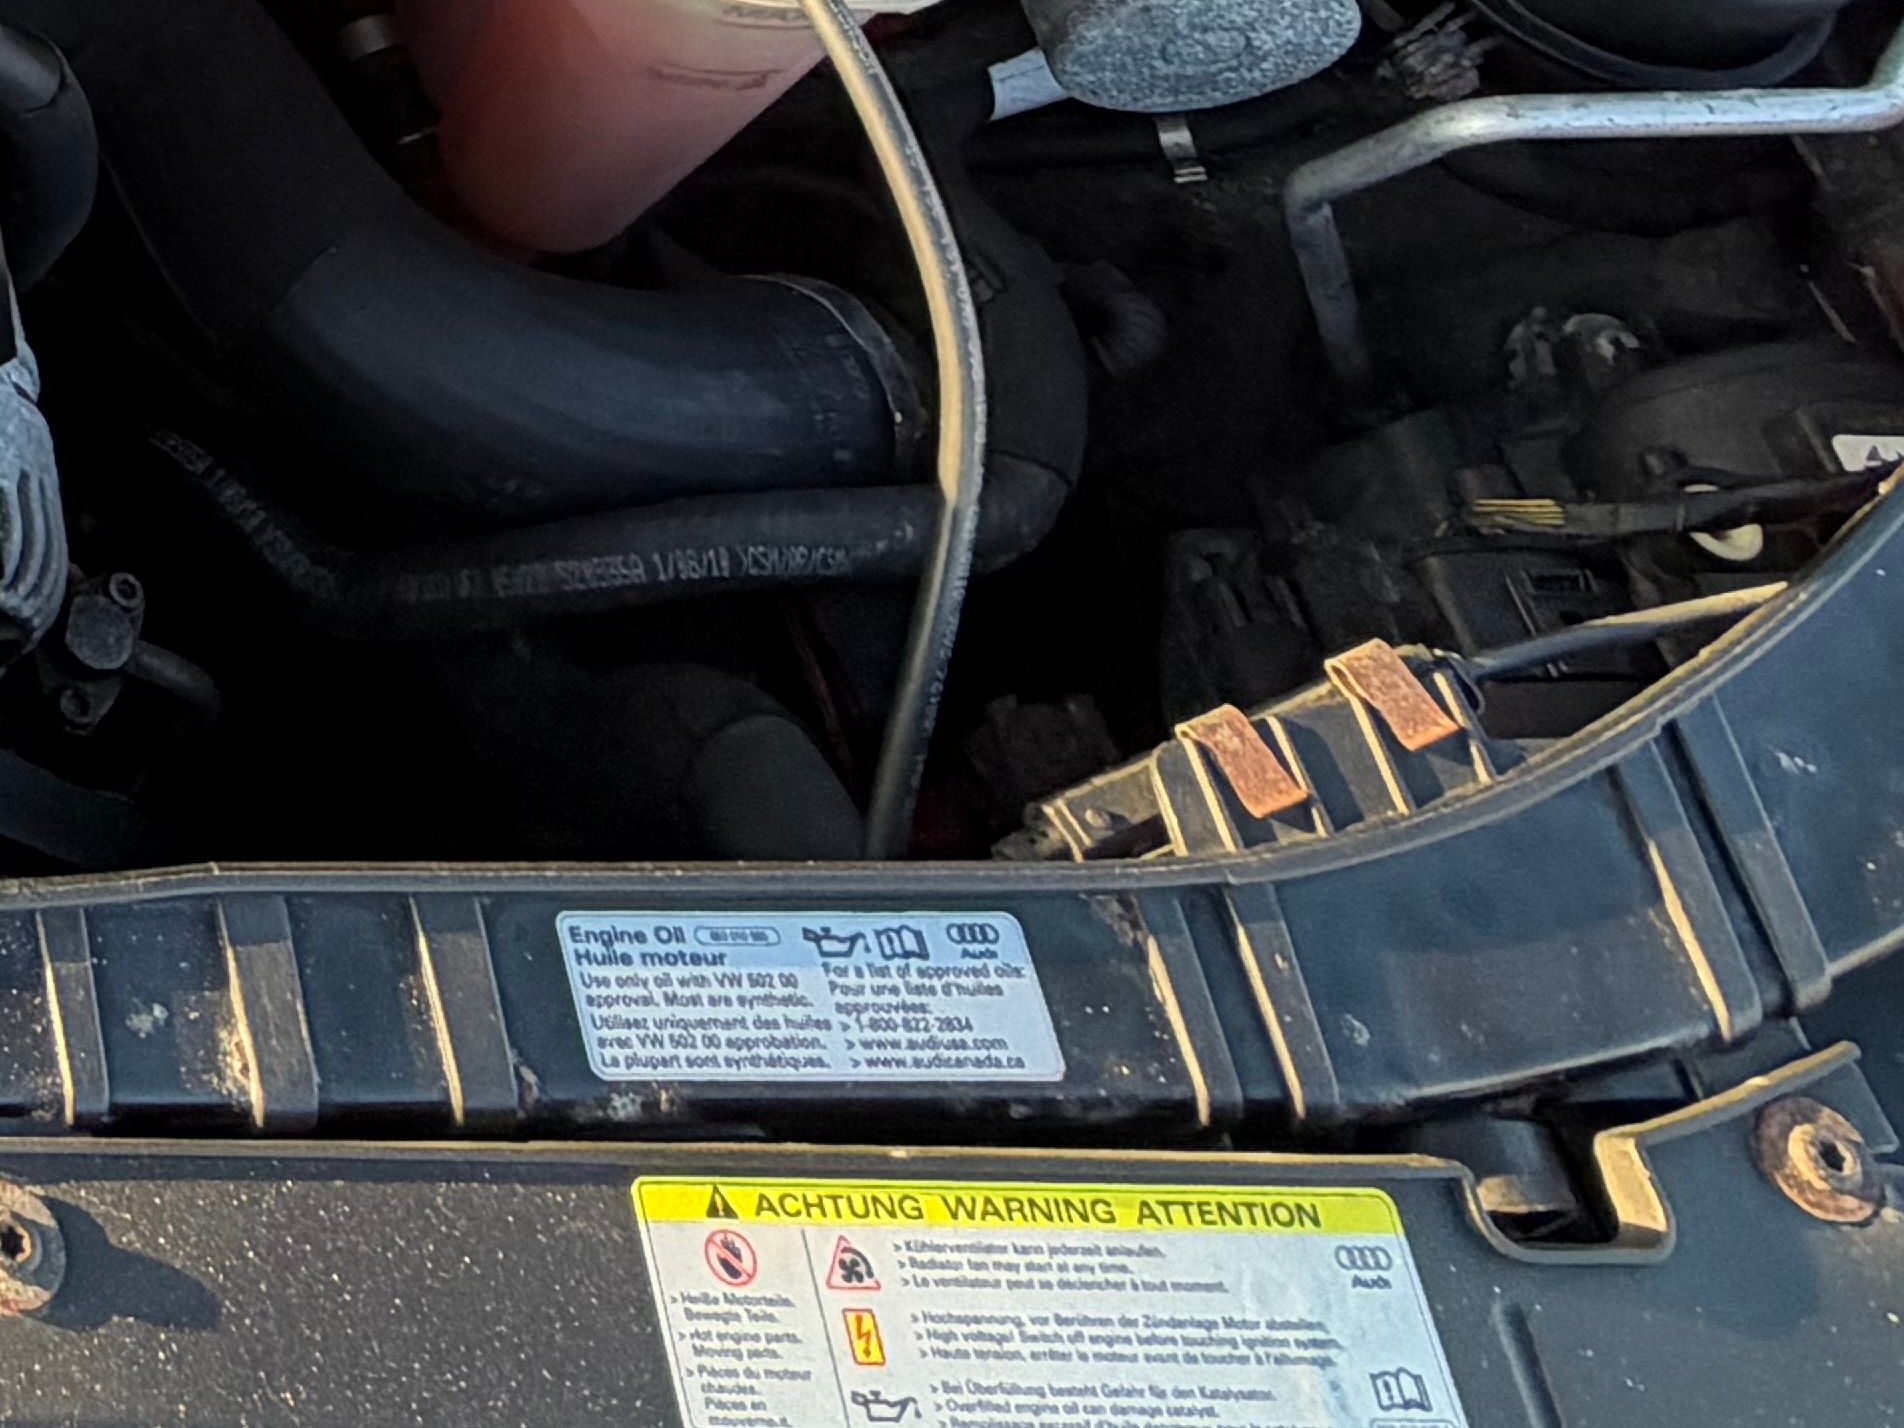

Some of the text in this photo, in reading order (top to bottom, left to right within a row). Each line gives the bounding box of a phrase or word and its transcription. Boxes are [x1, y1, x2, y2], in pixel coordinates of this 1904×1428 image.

[569, 925, 648, 952] Engine
[654, 926, 687, 944] Oil
[575, 948, 727, 967] Huile moteur
[821, 961, 849, 978] For
[853, 965, 864, 978] a
[866, 962, 891, 978] list
[896, 962, 910, 980] of
[916, 962, 990, 981] approved
[579, 973, 798, 994] Use only oil with VW 502 00
[828, 980, 865, 996] Pour
[870, 984, 901, 997] une
[903, 980, 937, 997] liste
[585, 991, 813, 1011] approval. Most are synthetic.
[591, 1013, 832, 1035] Utilisez uniquement des huiles
[597, 1033, 827, 1051] avec VW 502 00 approbation.
[859, 1035, 1009, 1051] www.audiusa.com
[601, 1052, 620, 1067] La
[624, 1051, 681, 1070] plupart
[684, 1054, 721, 1068] sont
[864, 1052, 1025, 1069] www.audicanada.ca
[754, 1193, 1321, 1228] ACHTUNG WARNING ATTENTION
[992, 1261, 1020, 1275] may
[1073, 1263, 1096, 1276] any
[911, 1273, 930, 1288] Le
[1351, 1274, 1392, 1290] Audi
[1028, 1315, 1050, 1326] vor
[1221, 1315, 1261, 1330] Motor
[1088, 1334, 1134, 1349] engine
[1134, 1332, 1179, 1346] before
[930, 1345, 971, 1360] Haute
[1092, 1351, 1139, 1363] moteur
[940, 1379, 964, 1394] Bei
[1014, 1403, 1060, 1417] engine
[1082, 1404, 1107, 1416] can
